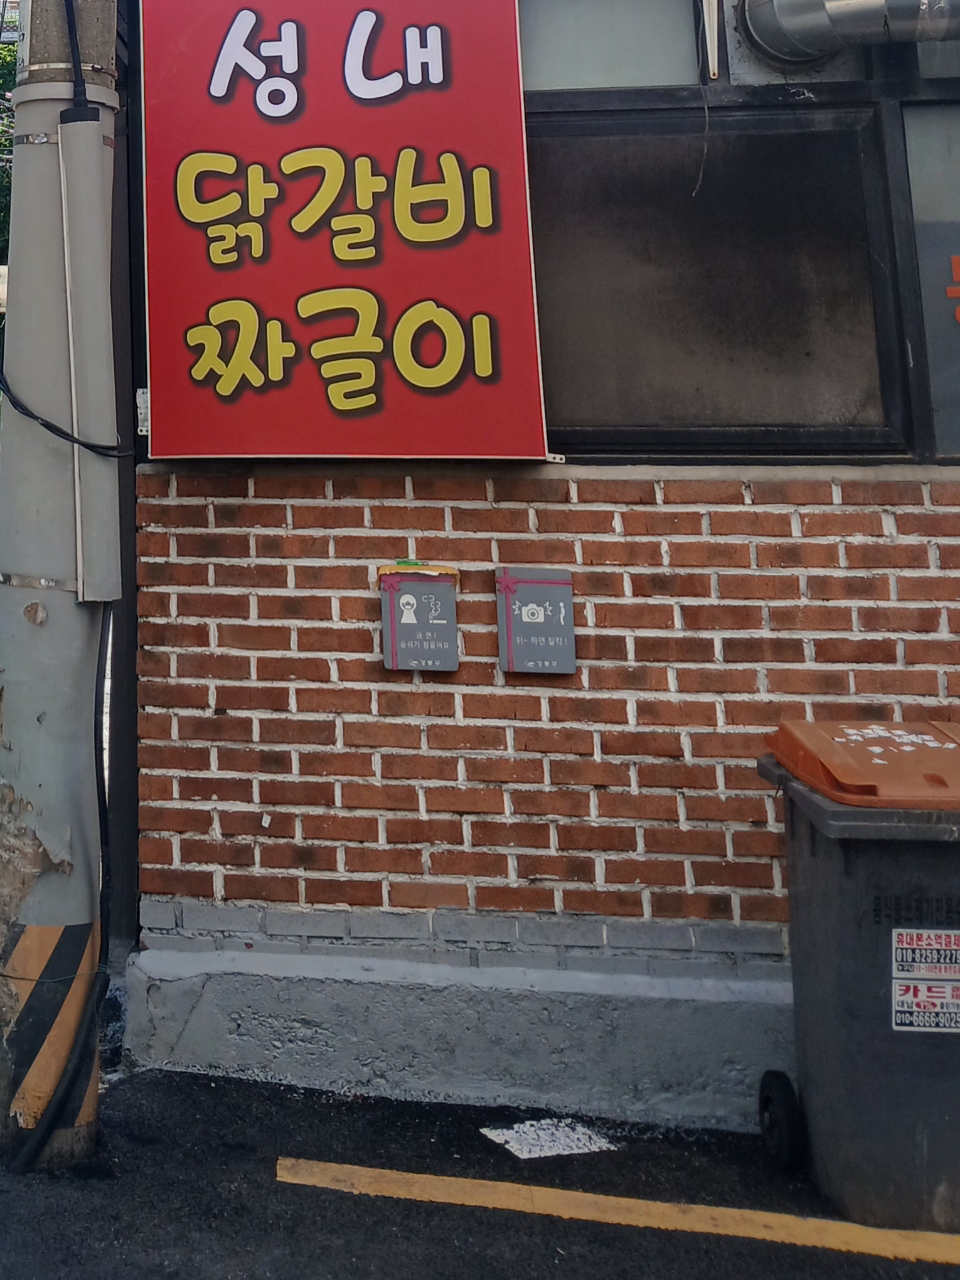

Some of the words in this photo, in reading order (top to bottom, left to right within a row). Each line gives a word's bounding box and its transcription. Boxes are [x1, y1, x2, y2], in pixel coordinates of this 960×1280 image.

[176, 146, 494, 264] 닭갈비
[185, 287, 494, 412] 짜글이
[897, 1000, 914, 1010] 대납
[898, 984, 947, 999] 카드
